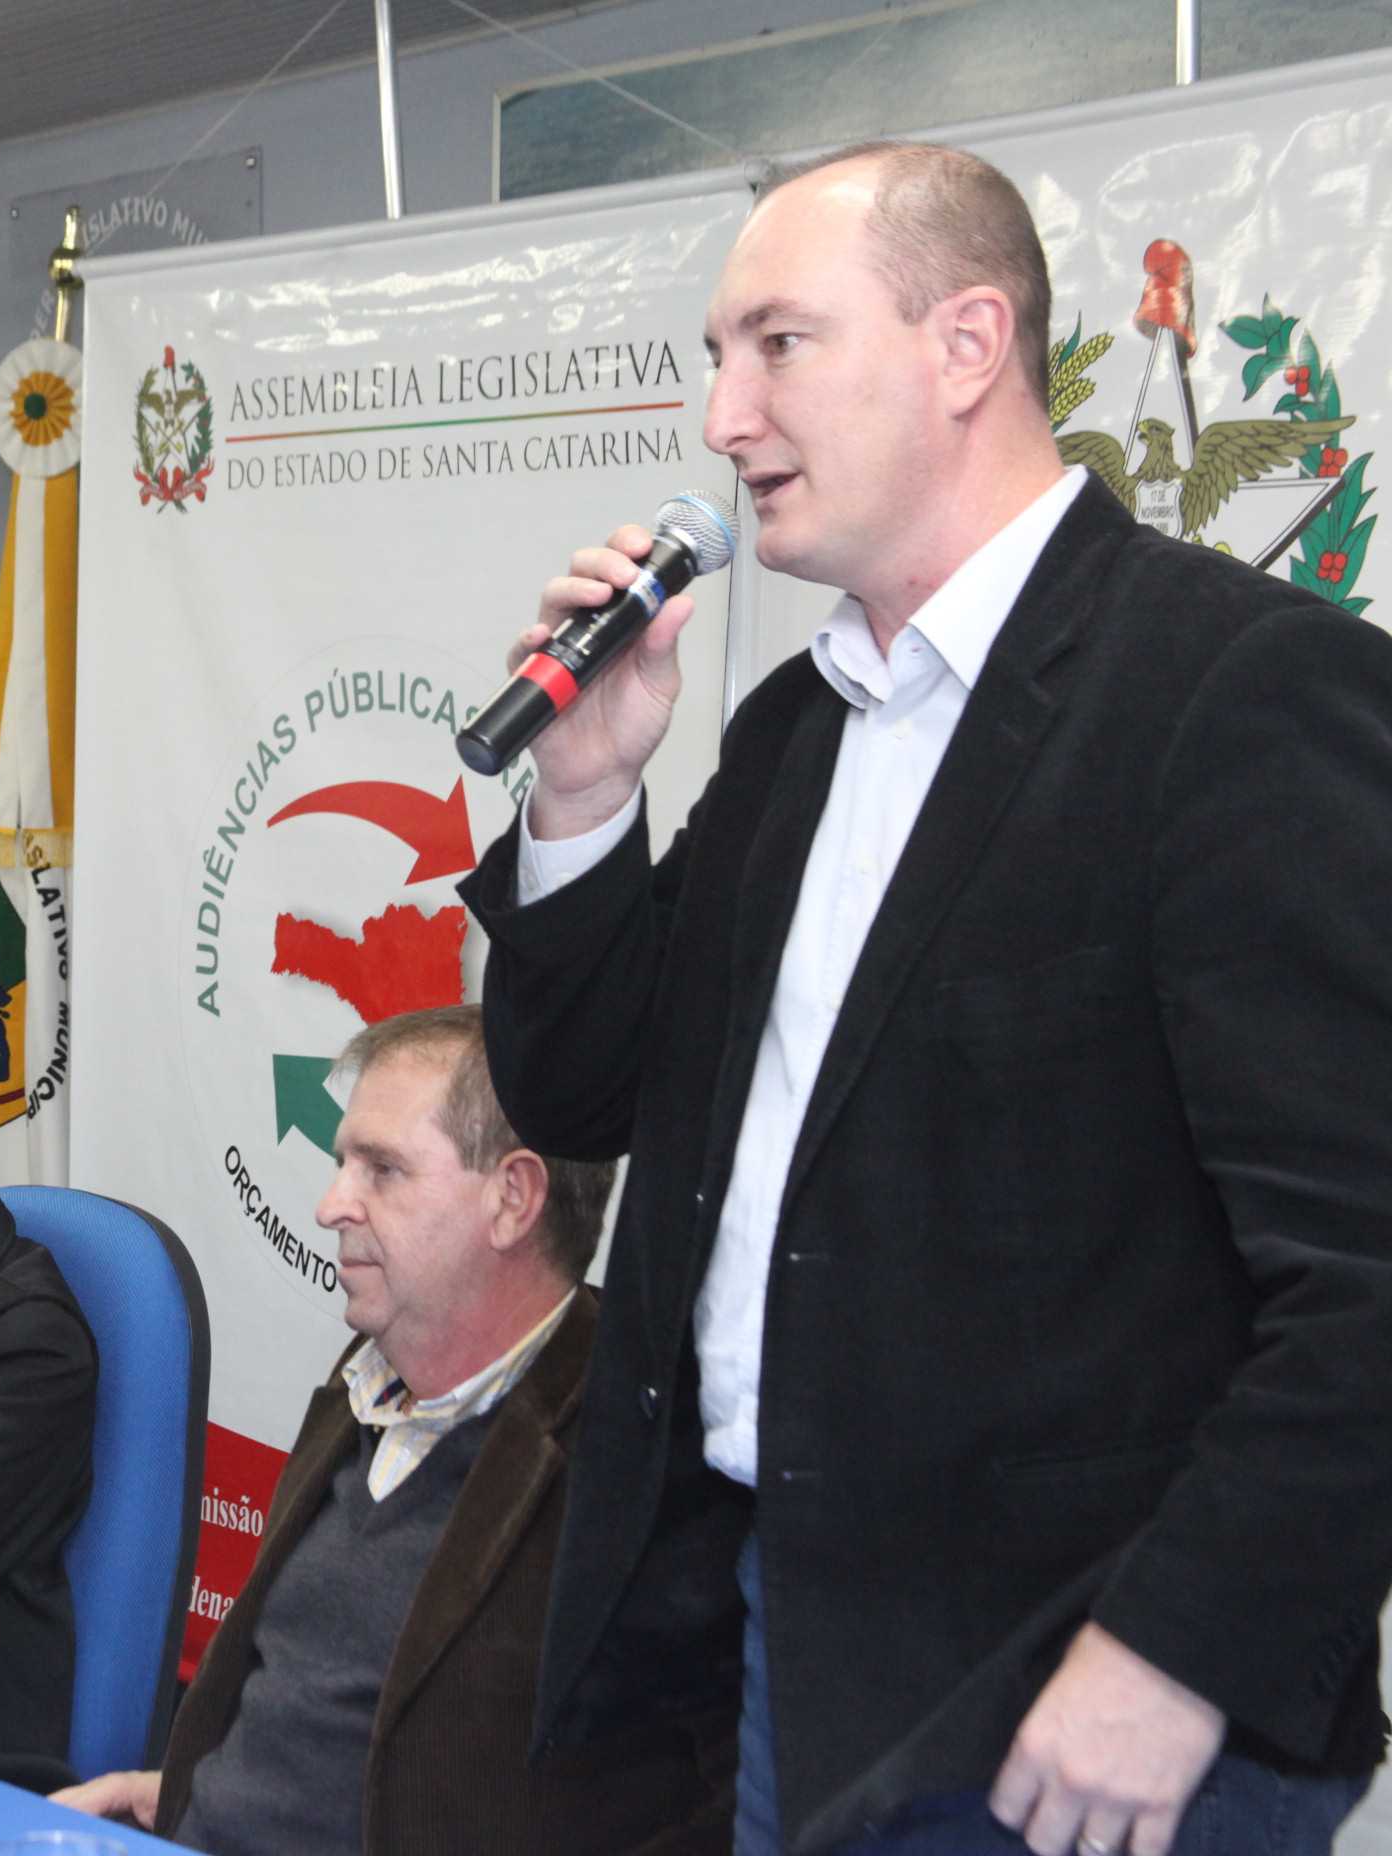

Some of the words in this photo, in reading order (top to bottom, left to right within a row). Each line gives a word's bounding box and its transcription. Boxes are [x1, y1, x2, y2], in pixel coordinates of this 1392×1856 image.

[81, 196, 168, 249] ISLATIVO
[229, 363, 423, 422] ASSEMBLEIA
[438, 339, 683, 404] LEGISLATIVA
[227, 457, 265, 490] DO
[274, 449, 367, 488] ESTADO
[377, 446, 412, 481] DE
[422, 439, 515, 479] SANTA
[523, 427, 683, 472] CATARINA
[195, 713, 297, 1018] AUDIÊNCIAS
[28, 1001, 68, 1120] MUNICIP
[224, 1145, 337, 1293] ORÇAMENTO
[201, 1486, 264, 1537] missão
